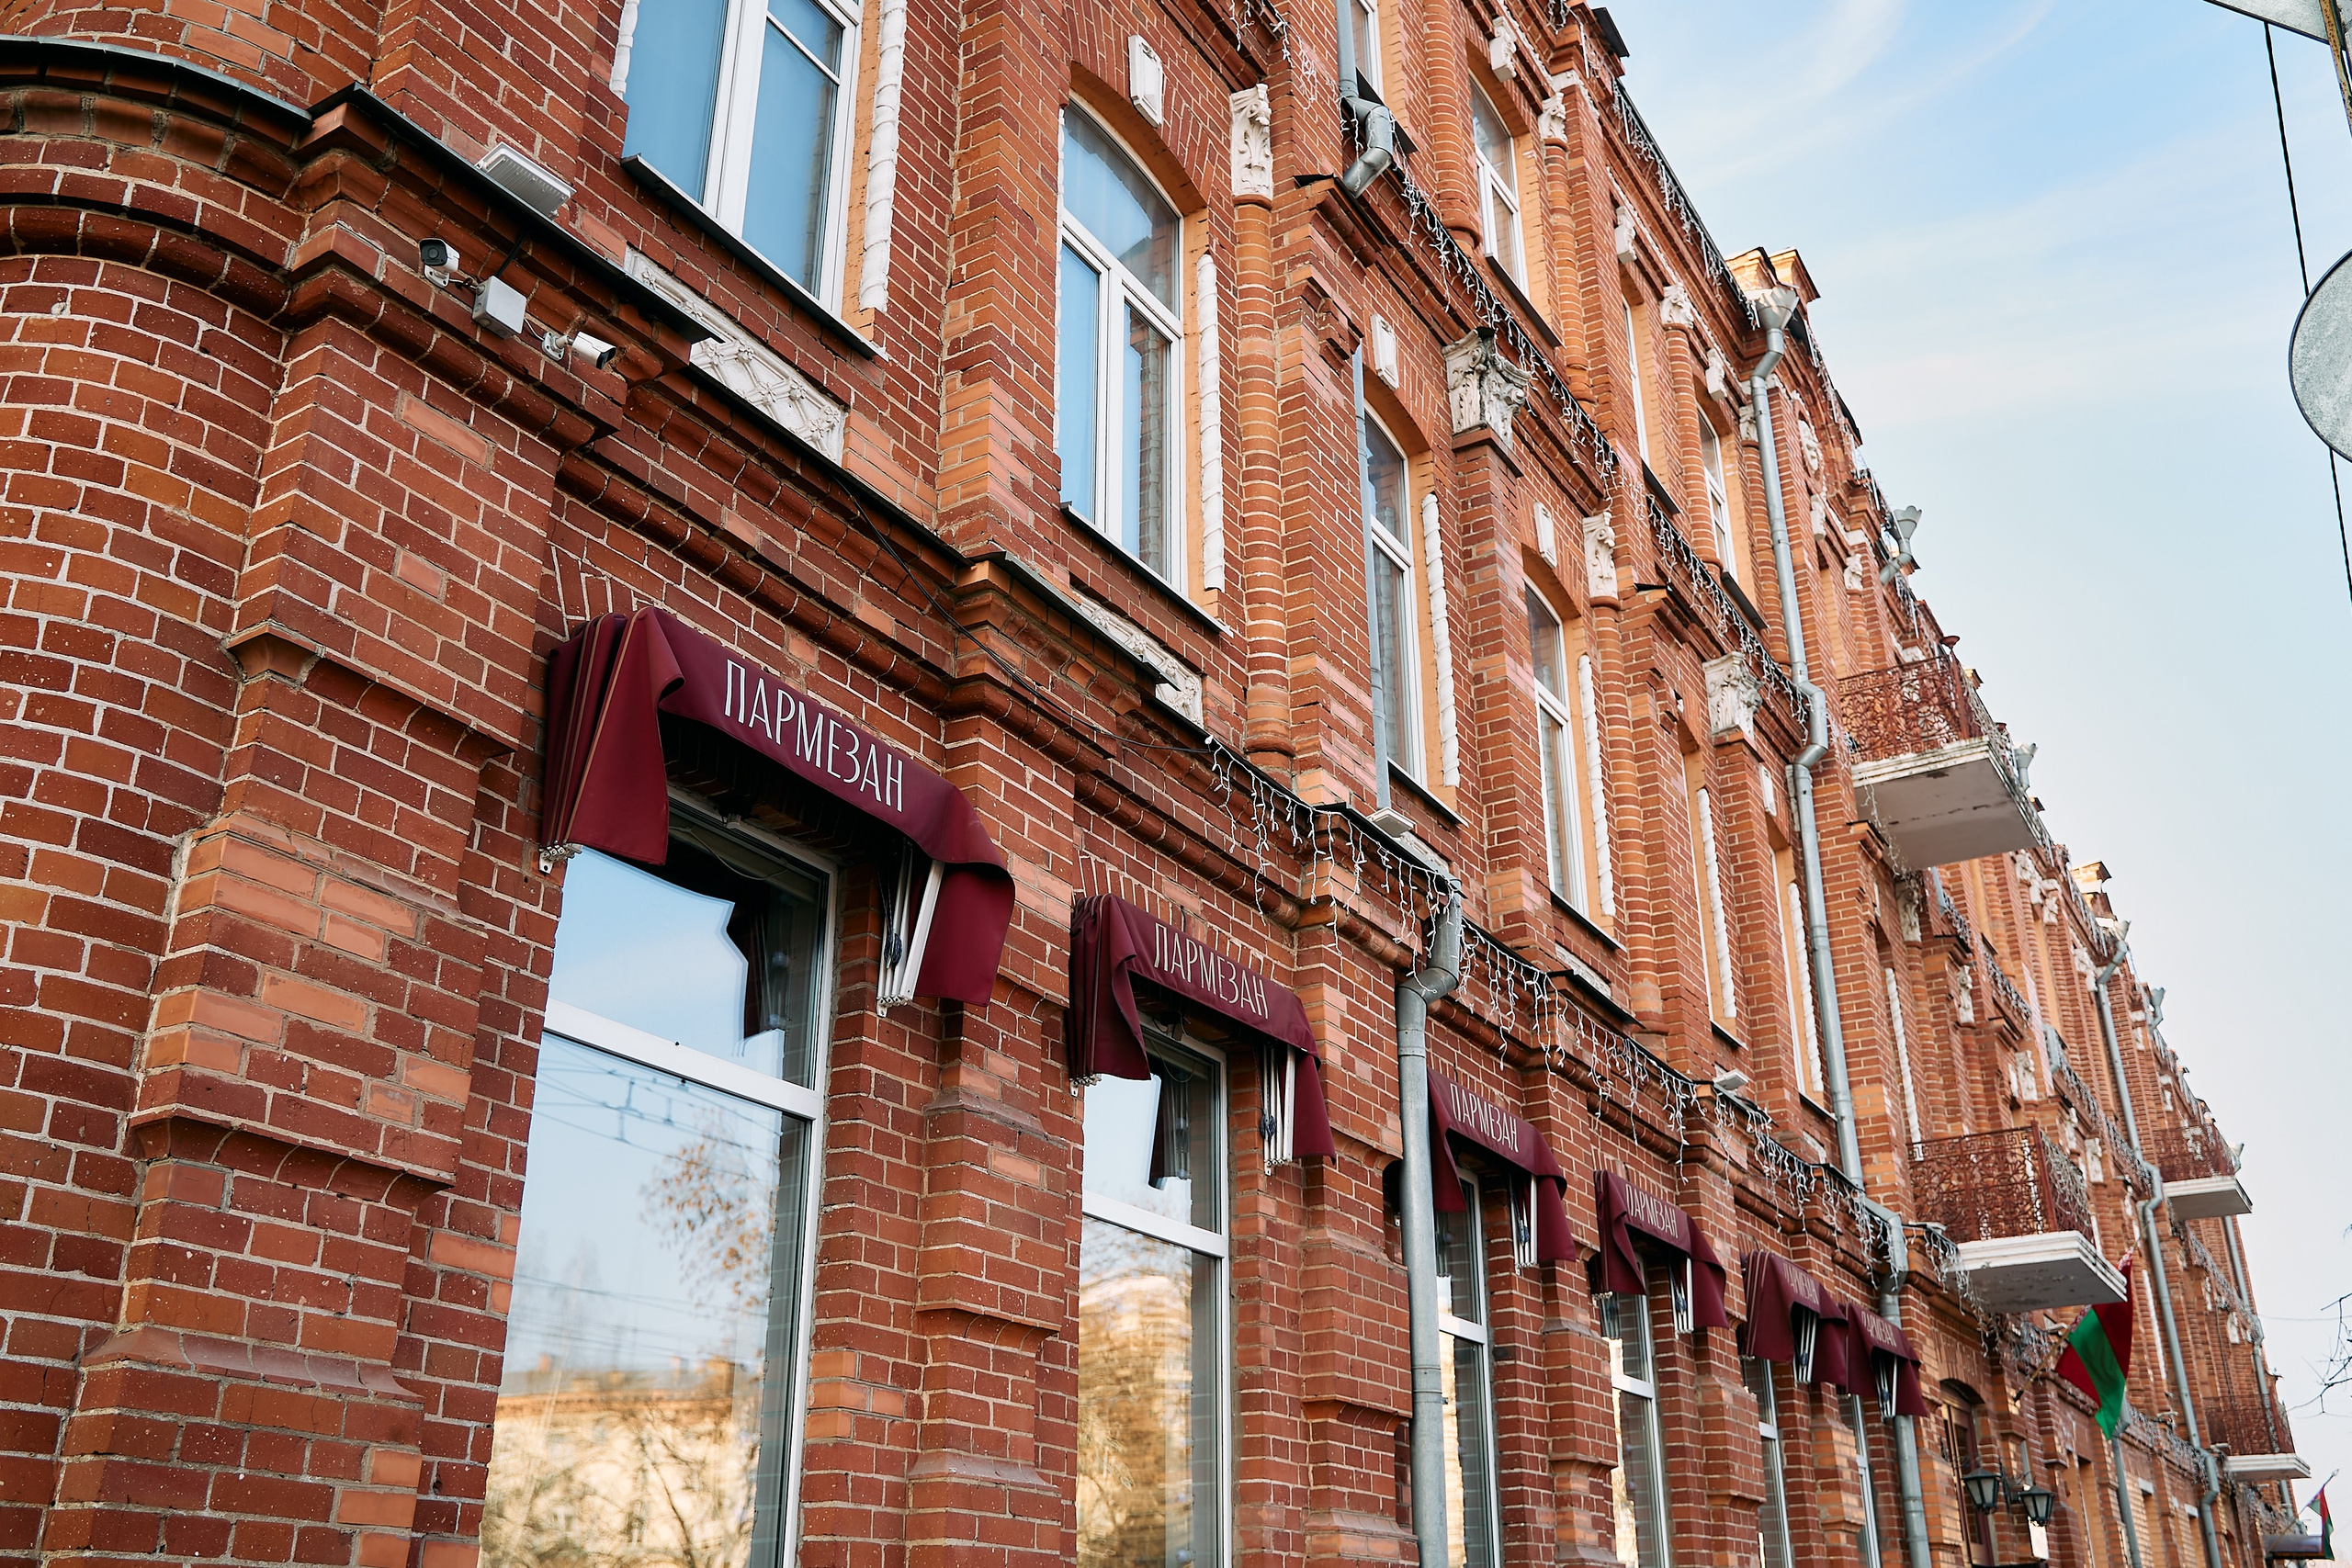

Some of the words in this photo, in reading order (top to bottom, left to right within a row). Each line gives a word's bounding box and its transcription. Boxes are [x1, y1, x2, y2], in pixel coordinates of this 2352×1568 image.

[723, 659, 903, 813] ПАРМЕЗАН
[1154, 922, 1269, 1020] ПАРМЕЗАН
[1450, 1083, 1519, 1153] ПАРМЕЗАН
[1625, 1183, 1679, 1239] ПАРМЕЗАН
